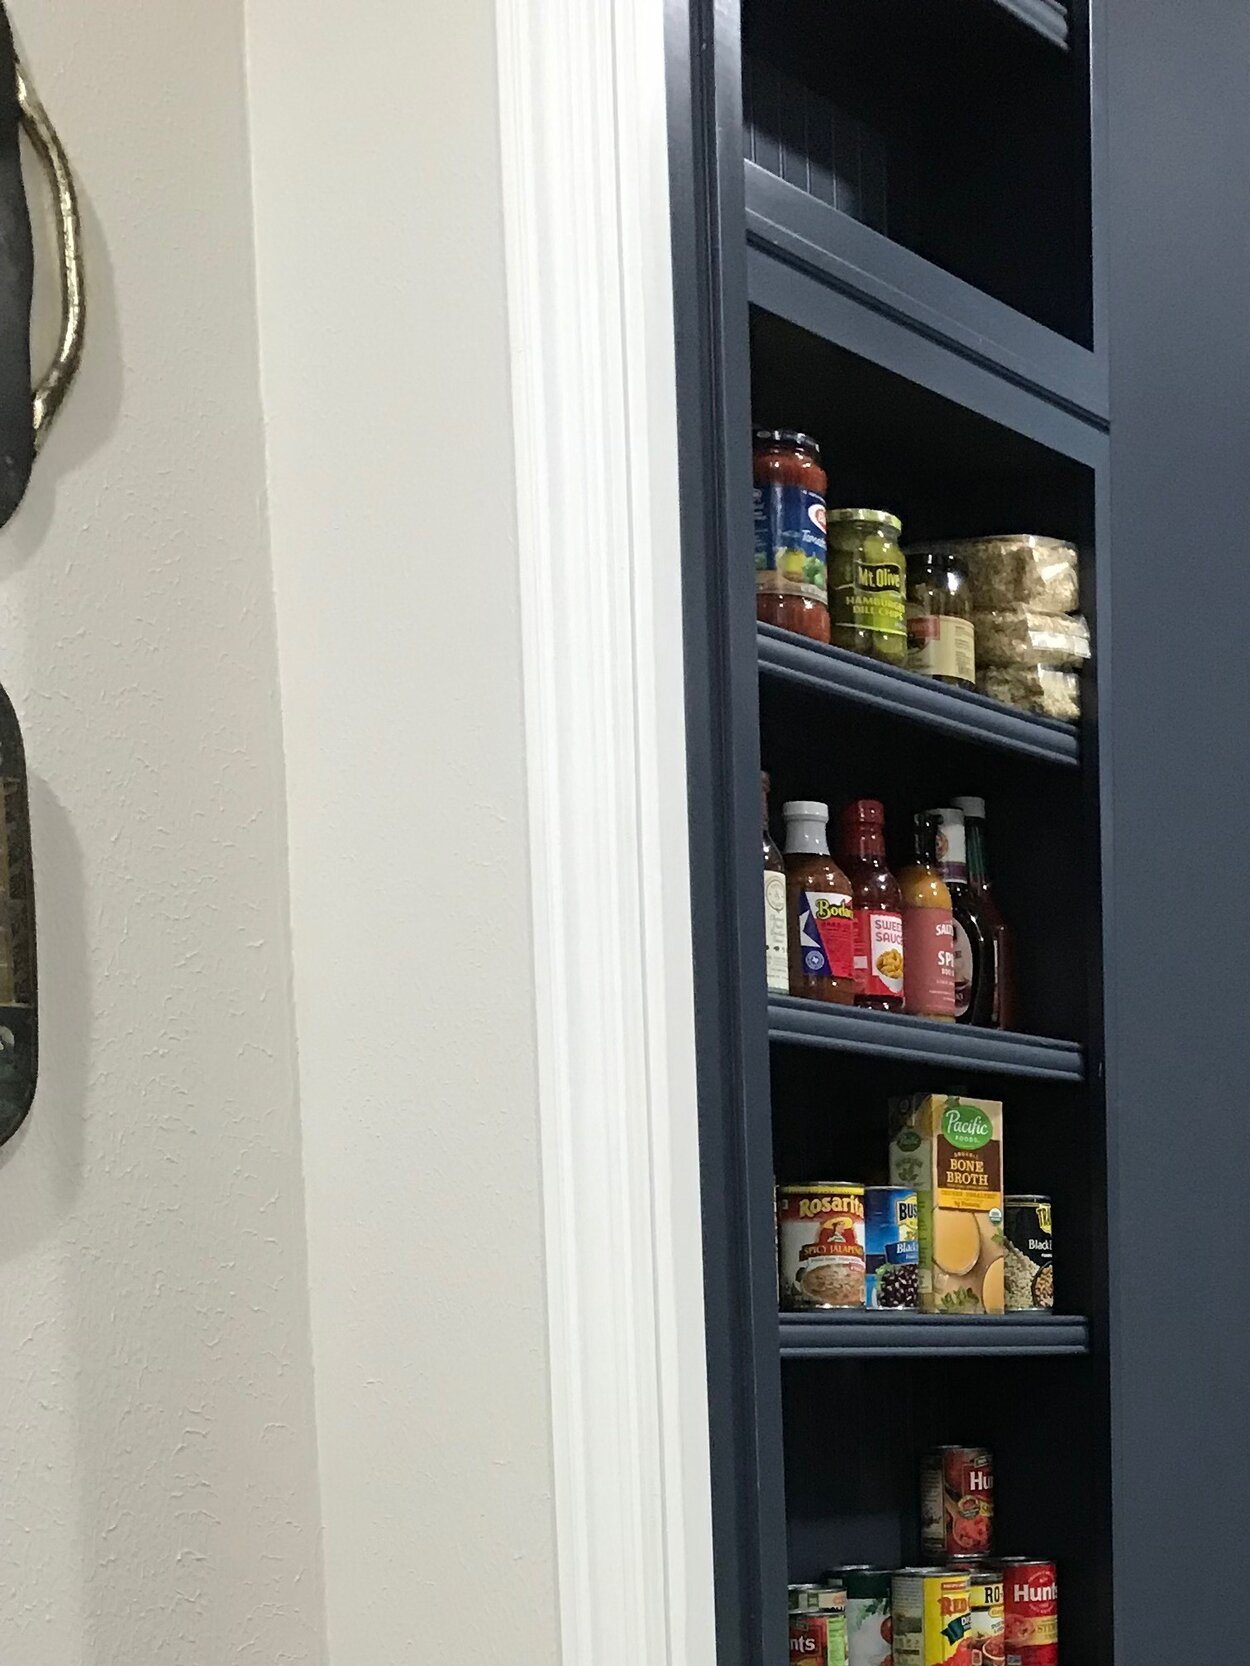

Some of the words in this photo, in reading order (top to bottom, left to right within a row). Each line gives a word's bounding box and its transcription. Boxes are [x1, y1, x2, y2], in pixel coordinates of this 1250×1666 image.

[858, 566, 875, 587] Mt.
[876, 567, 900, 588] Olive
[946, 1109, 989, 1136] Pacific
[949, 1158, 984, 1173] BONE
[946, 1171, 989, 1186] BROTH
